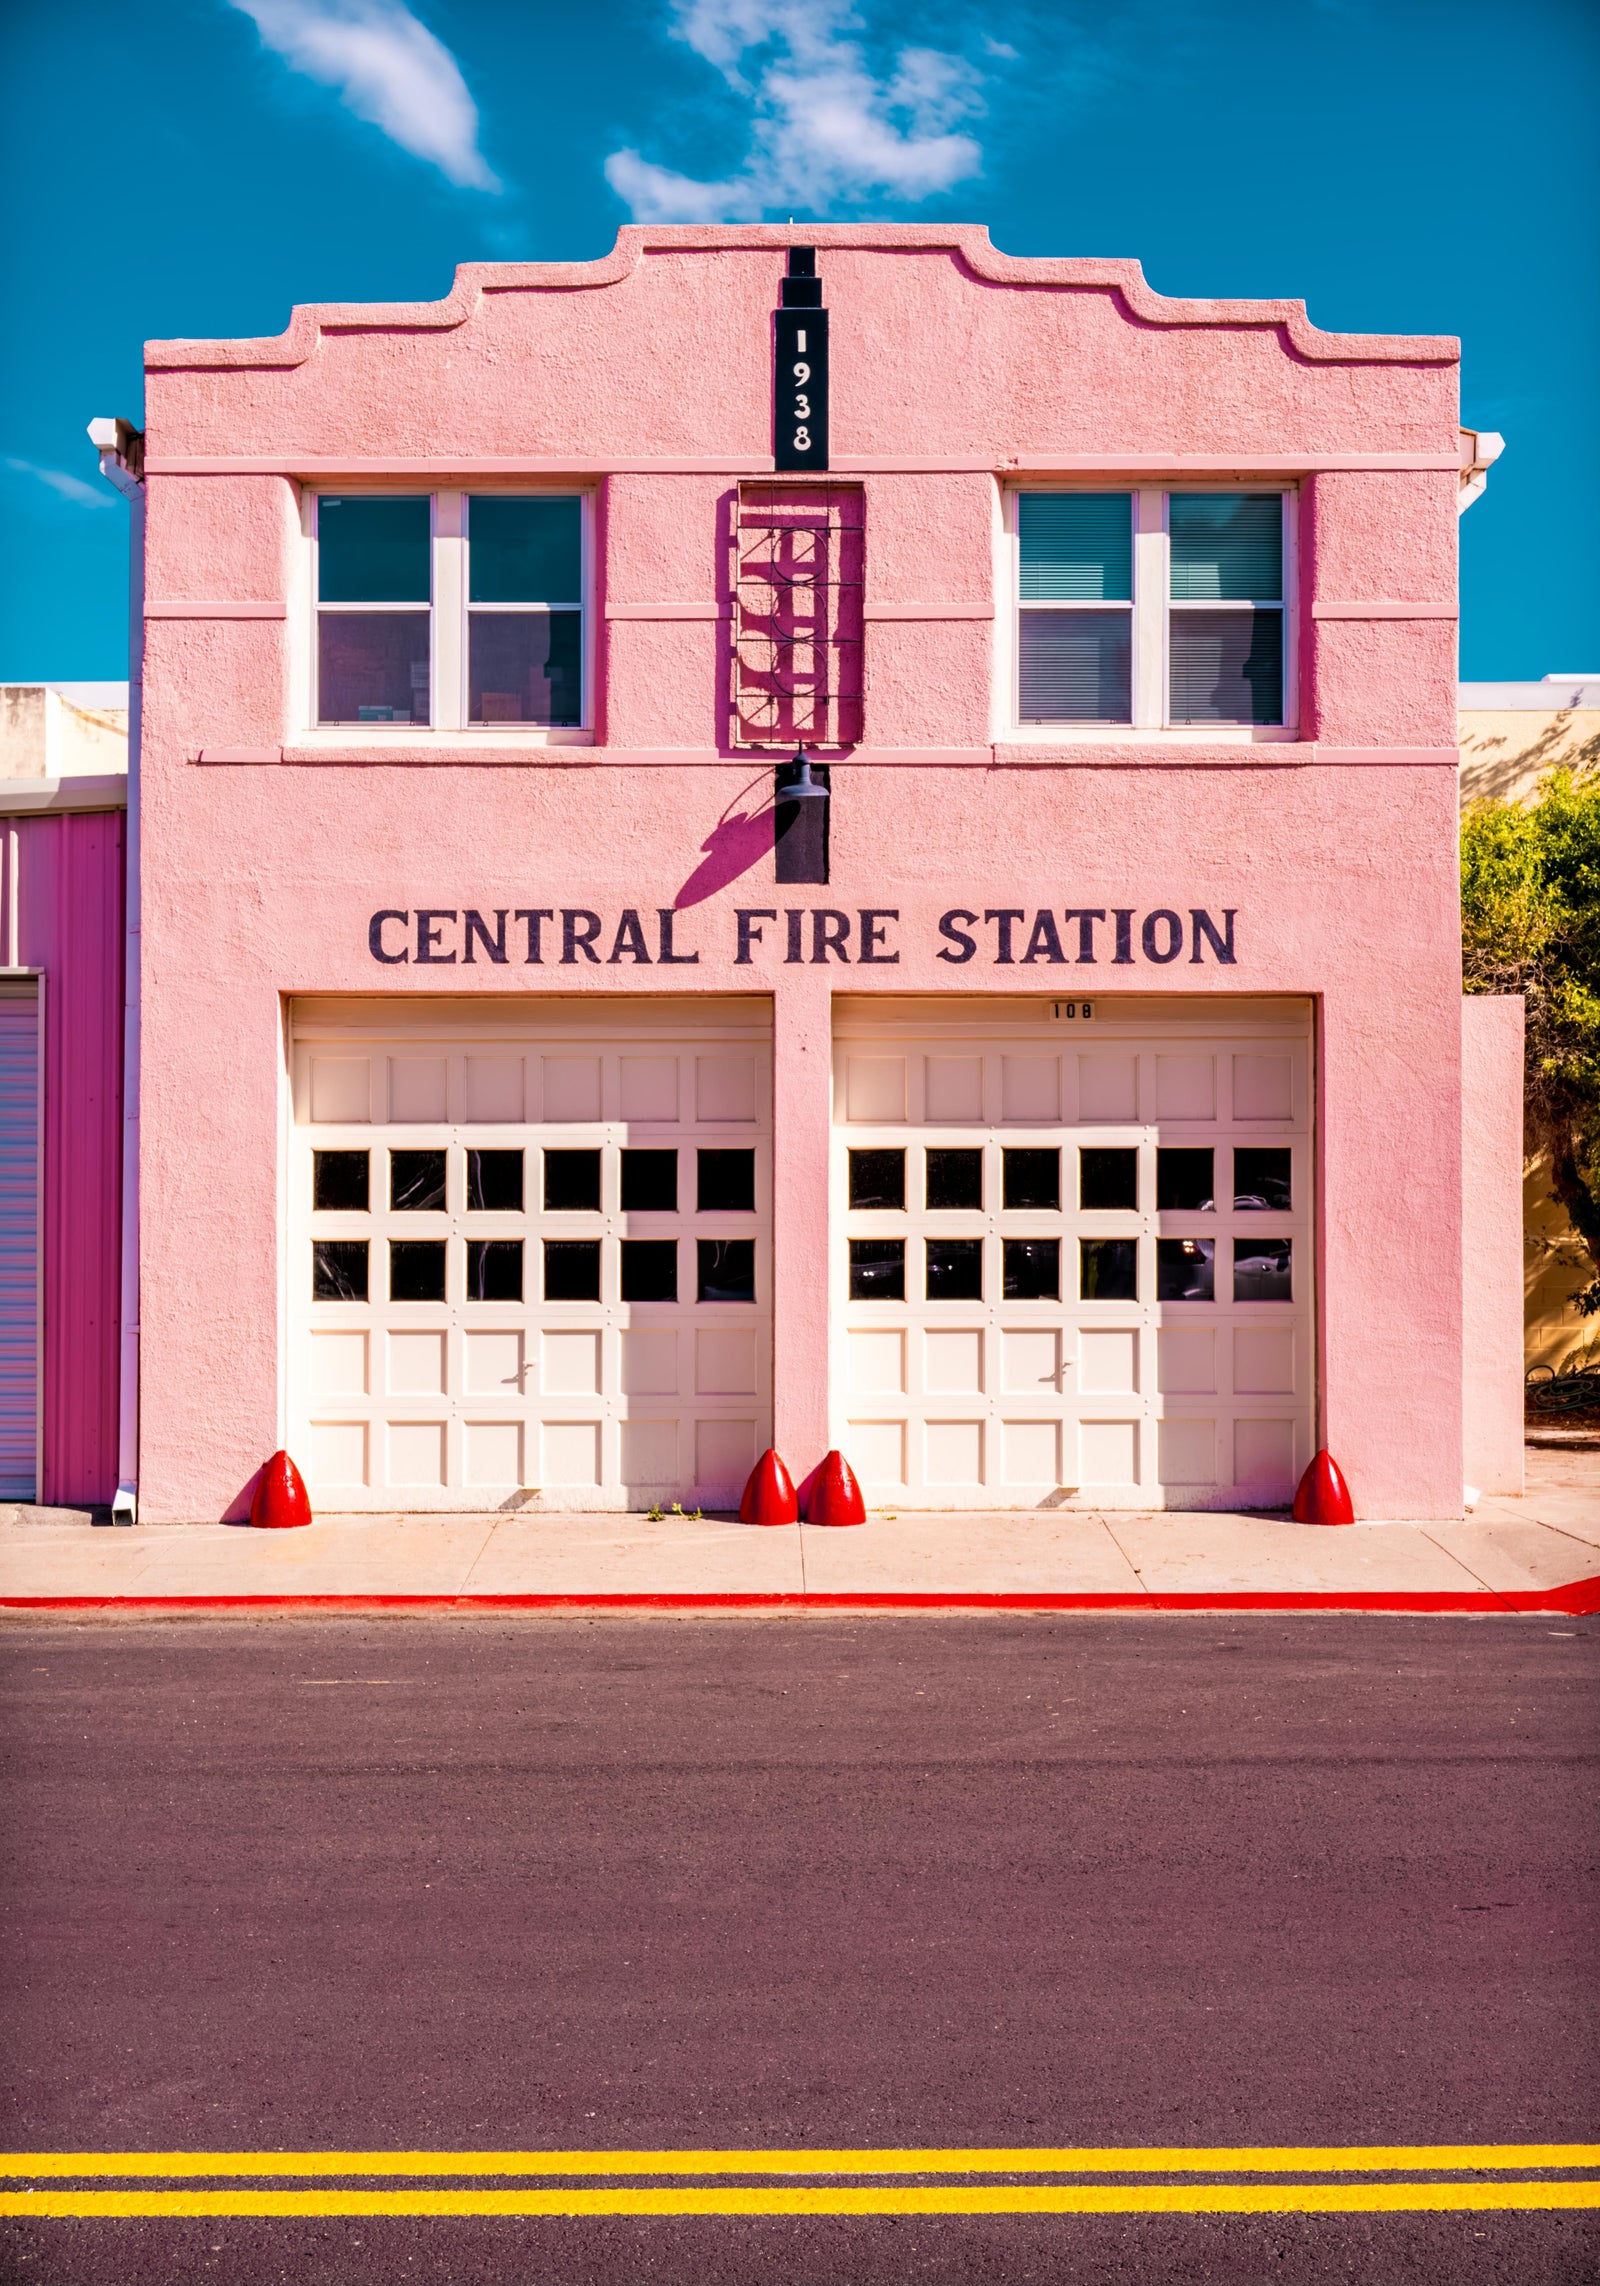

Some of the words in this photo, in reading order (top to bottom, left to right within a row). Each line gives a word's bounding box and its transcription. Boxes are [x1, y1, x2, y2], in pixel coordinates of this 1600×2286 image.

[793, 329, 811, 451] 1938
[368, 908, 700, 964] CENTRAL
[734, 908, 900, 964] FIRE
[936, 908, 1238, 964] STATION
[1054, 1003, 1092, 1019] 108
